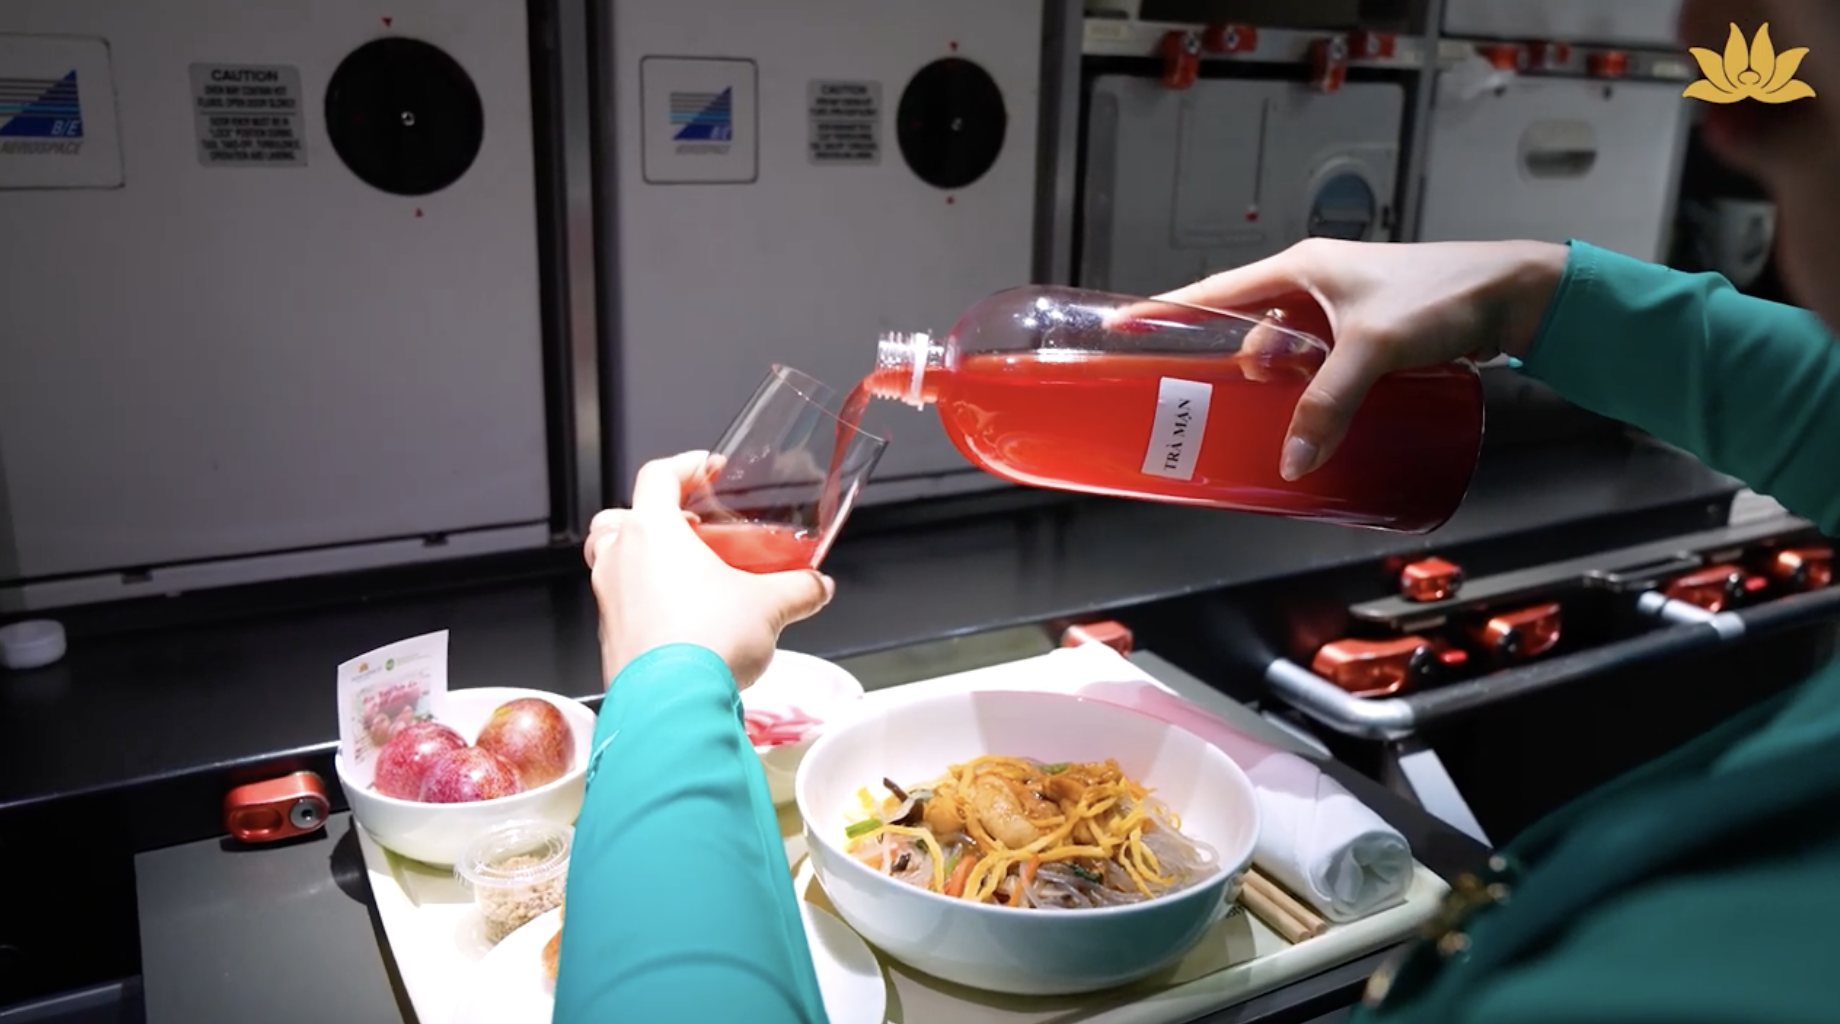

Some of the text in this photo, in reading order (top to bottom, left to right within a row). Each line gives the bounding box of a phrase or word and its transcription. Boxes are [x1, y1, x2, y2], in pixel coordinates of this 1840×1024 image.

[211, 69, 278, 82] CAUTION
[50, 119, 80, 136] B/E
[0, 141, 84, 155] AEROSPACE
[1164, 442, 1183, 470] TRÀ
